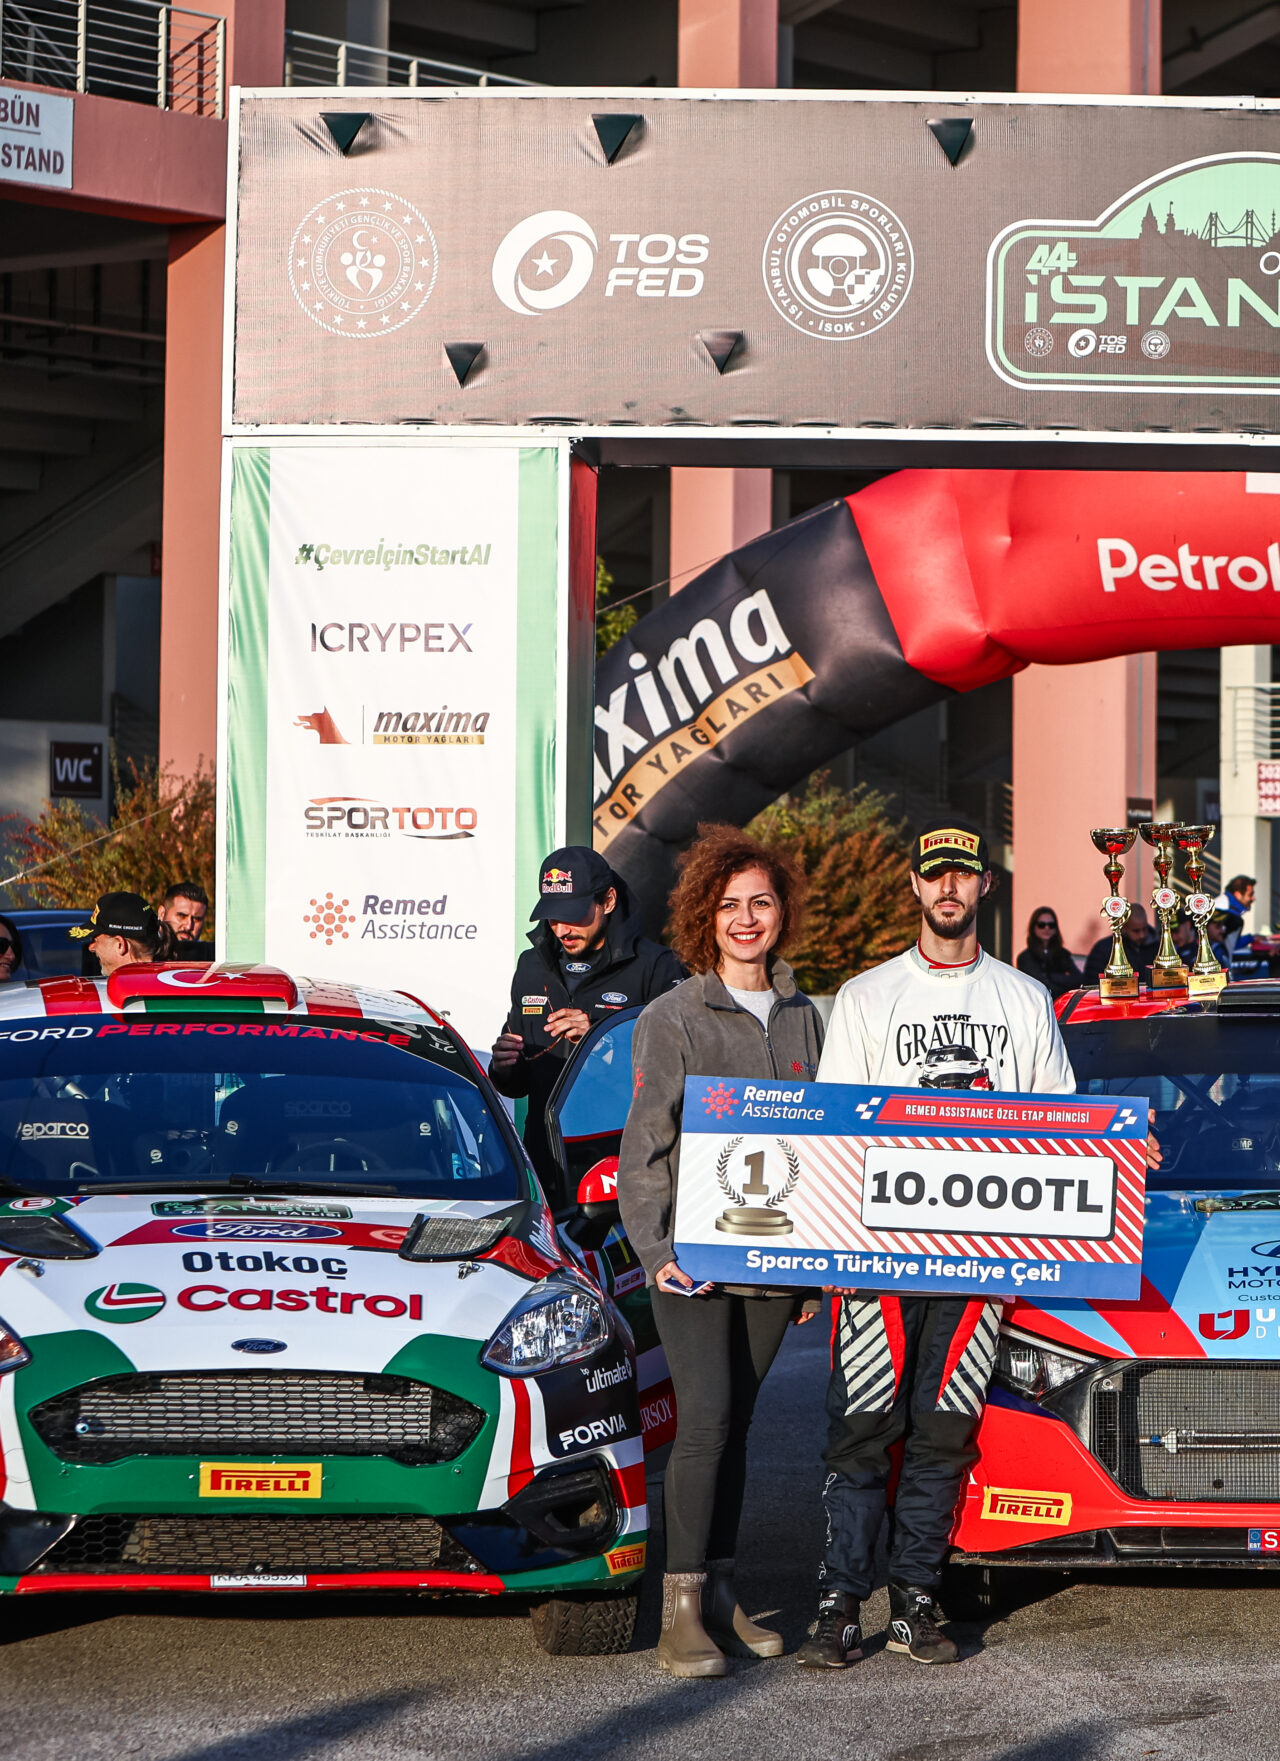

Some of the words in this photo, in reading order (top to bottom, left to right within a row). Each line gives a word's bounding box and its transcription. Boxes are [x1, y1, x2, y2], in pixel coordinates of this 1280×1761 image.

[2, 143, 65, 175] STAND
[850, 199, 906, 257] SPORLARI
[390, 226, 402, 238] VE
[399, 239, 411, 264] SPOR
[609, 233, 710, 265] TOS
[604, 267, 706, 298] FED
[1098, 335, 1127, 345] TOS
[1098, 345, 1126, 354] FED
[311, 622, 473, 653] ICRYPEX
[373, 704, 490, 734] maxima
[383, 735, 421, 744] MOTOR
[55, 757, 92, 783] WC
[304, 806, 478, 831] SPORTOTO
[923, 832, 975, 851] PIRELLI
[362, 894, 447, 916] Remed
[361, 917, 478, 940] Assistance
[933, 1014, 972, 1022] WHAT
[96, 1023, 411, 1047] PERFORMANCE
[896, 1022, 1008, 1068] GRAVITY?
[743, 1085, 804, 1103] Remed
[742, 1103, 825, 1122] Assistance
[905, 1104, 937, 1118] REMED
[939, 1105, 994, 1120] ASSISTANCE
[996, 1104, 1019, 1120] ÖZEL
[1021, 1108, 1044, 1122] ETAP
[1046, 1107, 1090, 1124] BİRİNCİSİ
[22, 1122, 89, 1139] sparco
[741, 1150, 769, 1195] 1
[870, 1170, 1104, 1214] 10.000TL
[205, 1222, 309, 1238] Ford
[745, 1250, 829, 1273] Sparco
[833, 1254, 920, 1280] Türkiye
[924, 1258, 1005, 1283] Hediye
[1010, 1262, 1061, 1287] Çeki
[177, 1284, 423, 1320] Castrol
[586, 1361, 628, 1393] ultimate
[558, 1414, 627, 1451] FORVIA
[210, 1469, 311, 1492] PIRELLI
[989, 1493, 1064, 1519] PIRELLI
[608, 1548, 644, 1568] PIRELLI
